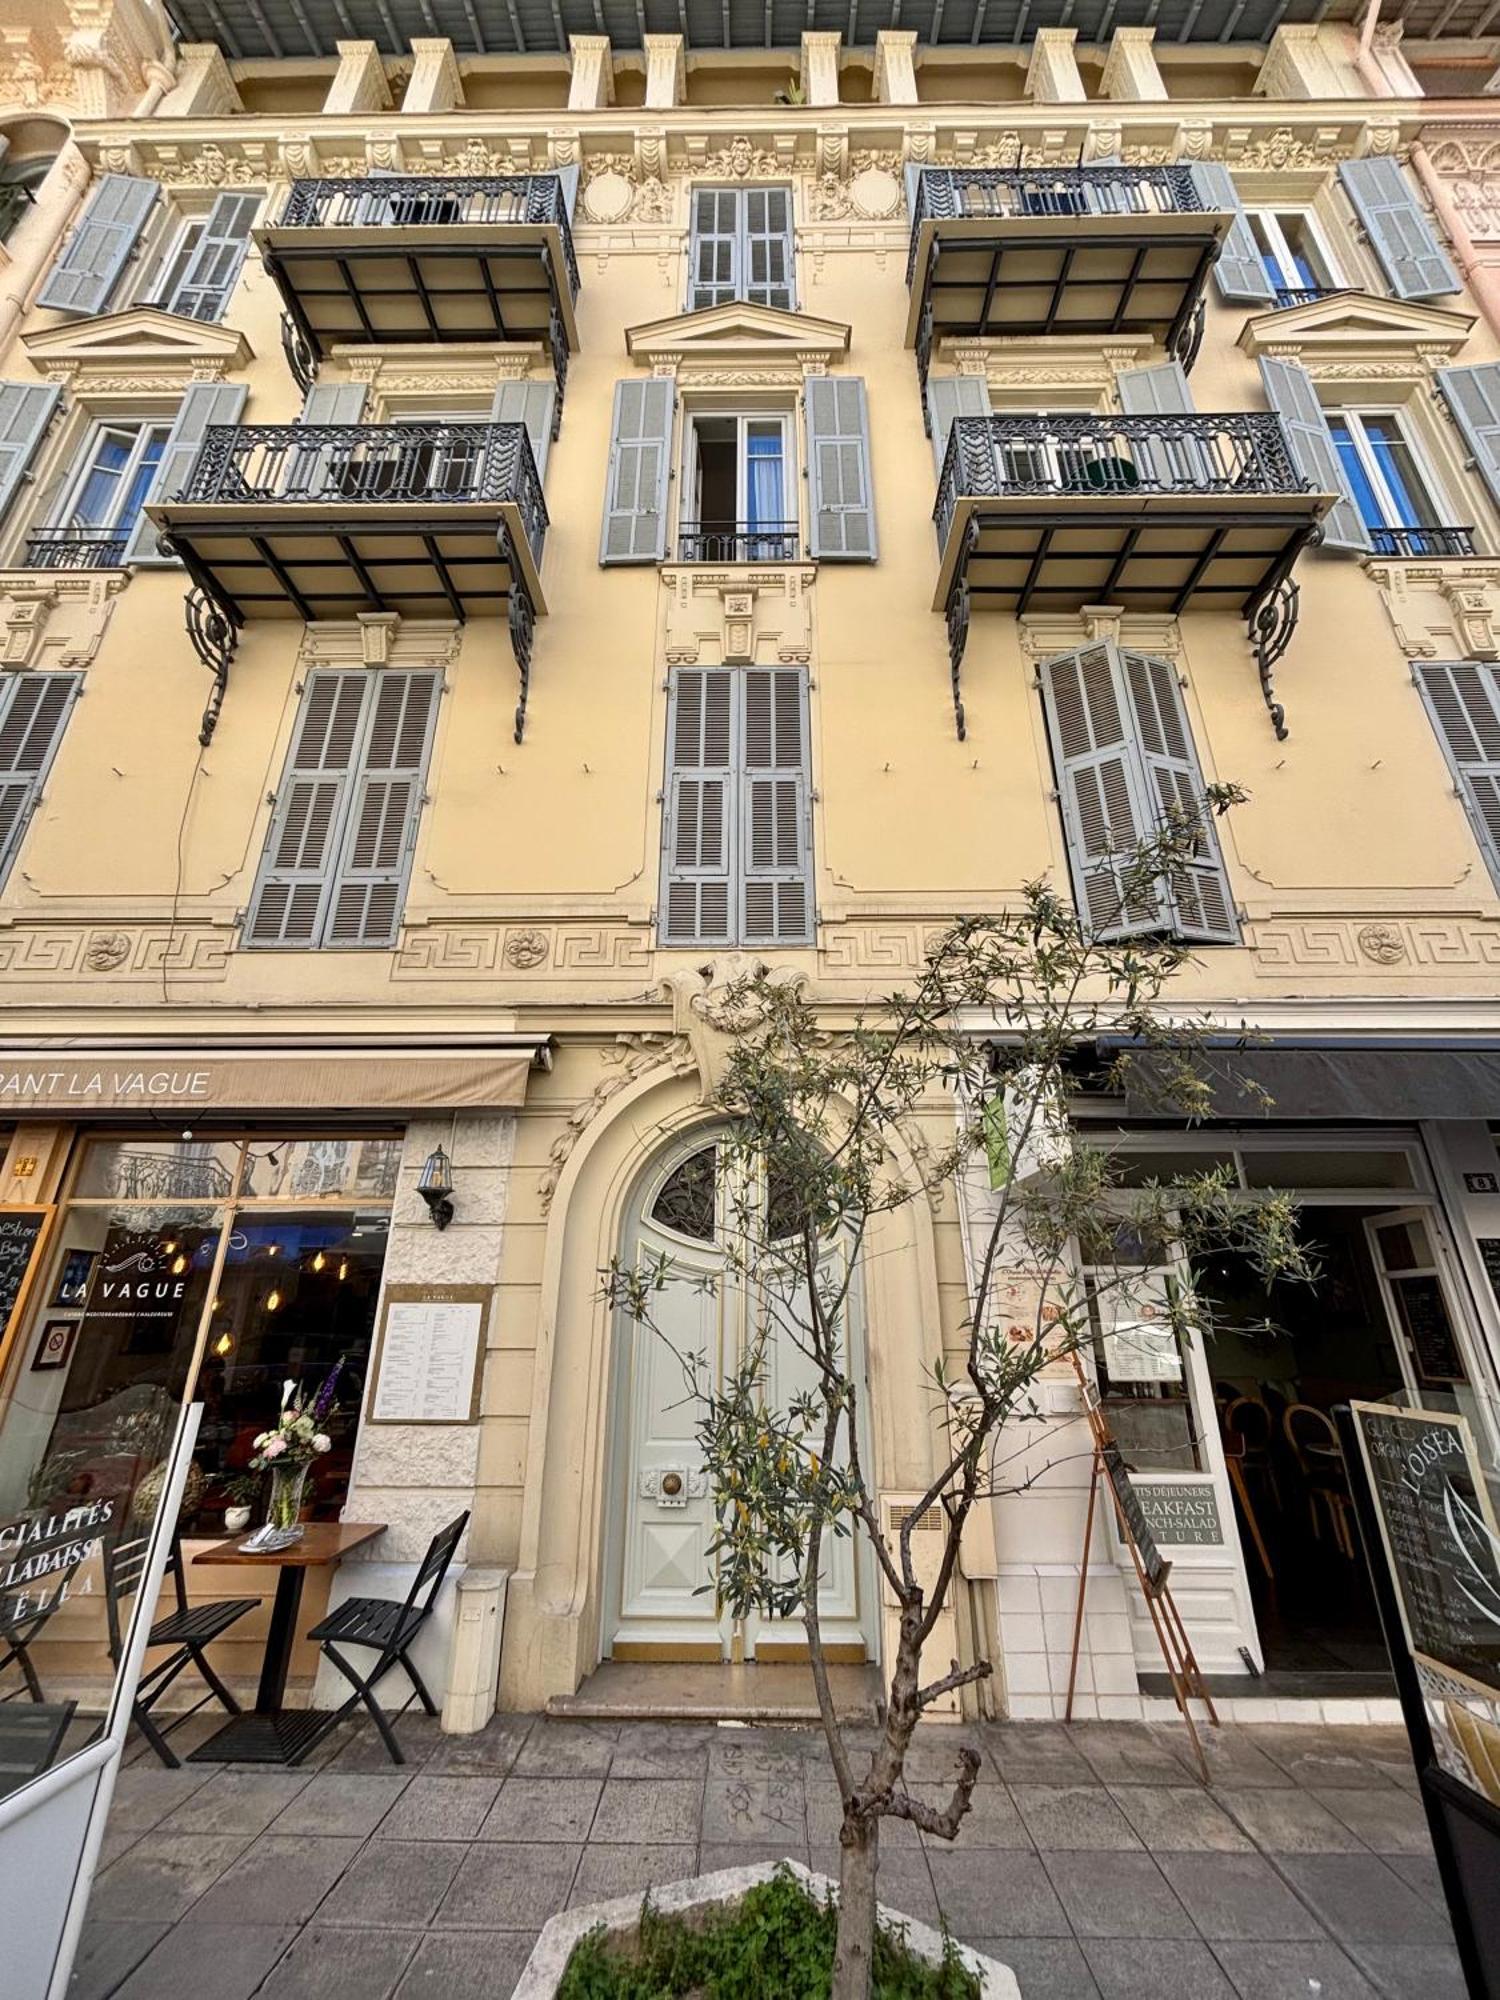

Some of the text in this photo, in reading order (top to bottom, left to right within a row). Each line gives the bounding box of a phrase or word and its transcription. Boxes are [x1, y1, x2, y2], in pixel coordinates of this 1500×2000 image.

[68, 1073, 102, 1095] LA
[114, 1072, 210, 1095] VAGUE
[61, 1282, 185, 1299] LA VAGUE
[1140, 1500, 1214, 1516] EAKFAST
[1145, 1518, 1217, 1529] NCH-SALAD
[1159, 1531, 1219, 1542] TURE
